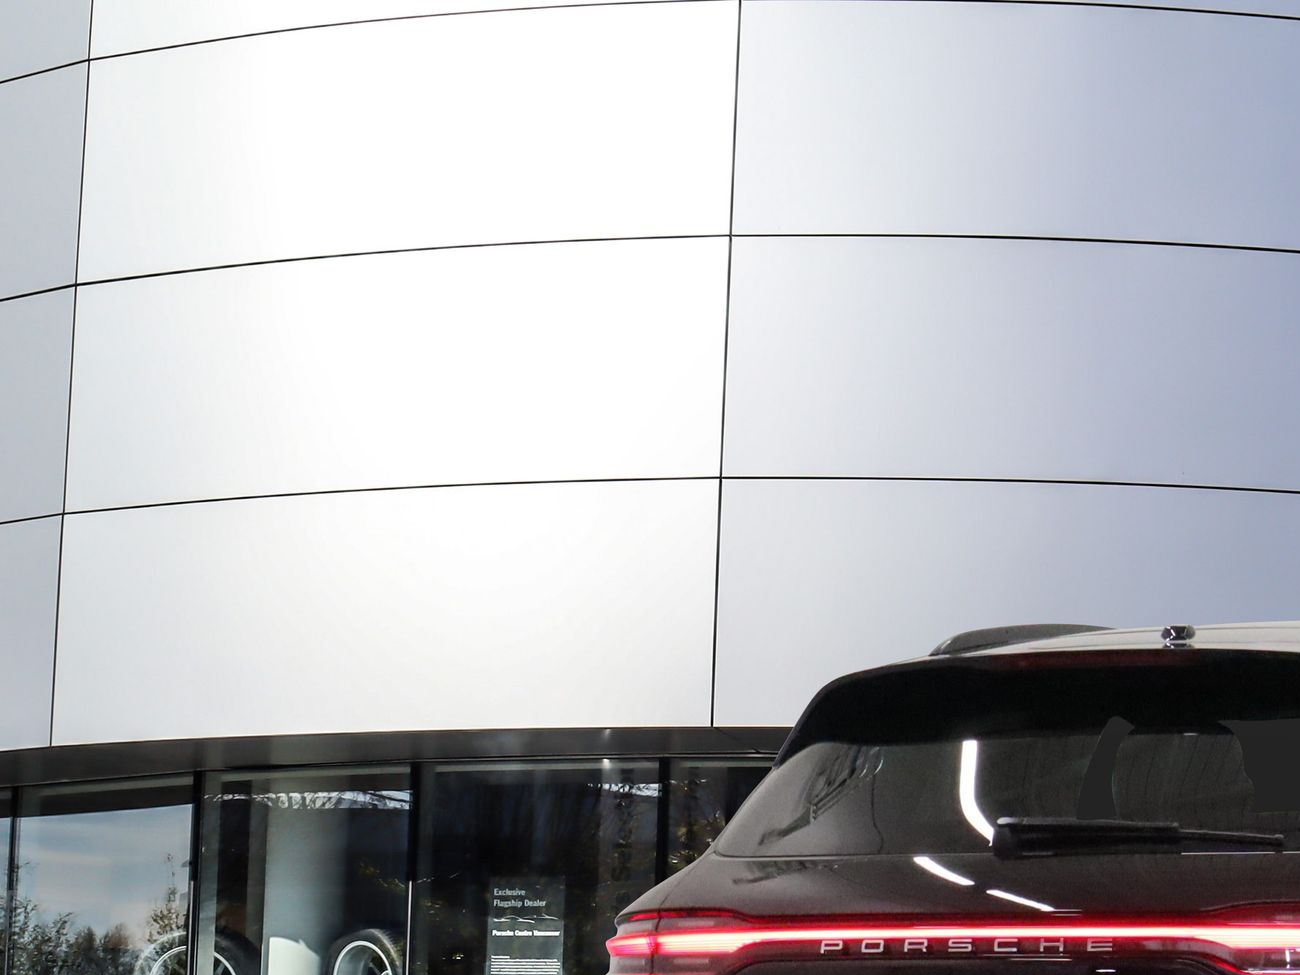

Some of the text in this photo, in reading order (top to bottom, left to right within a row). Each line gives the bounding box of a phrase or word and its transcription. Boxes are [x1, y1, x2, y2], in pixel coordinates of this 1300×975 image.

[493, 888, 526, 896] Exclusive
[493, 899, 547, 908] Flagship Dealer
[820, 937, 1114, 954] PORSCHE
